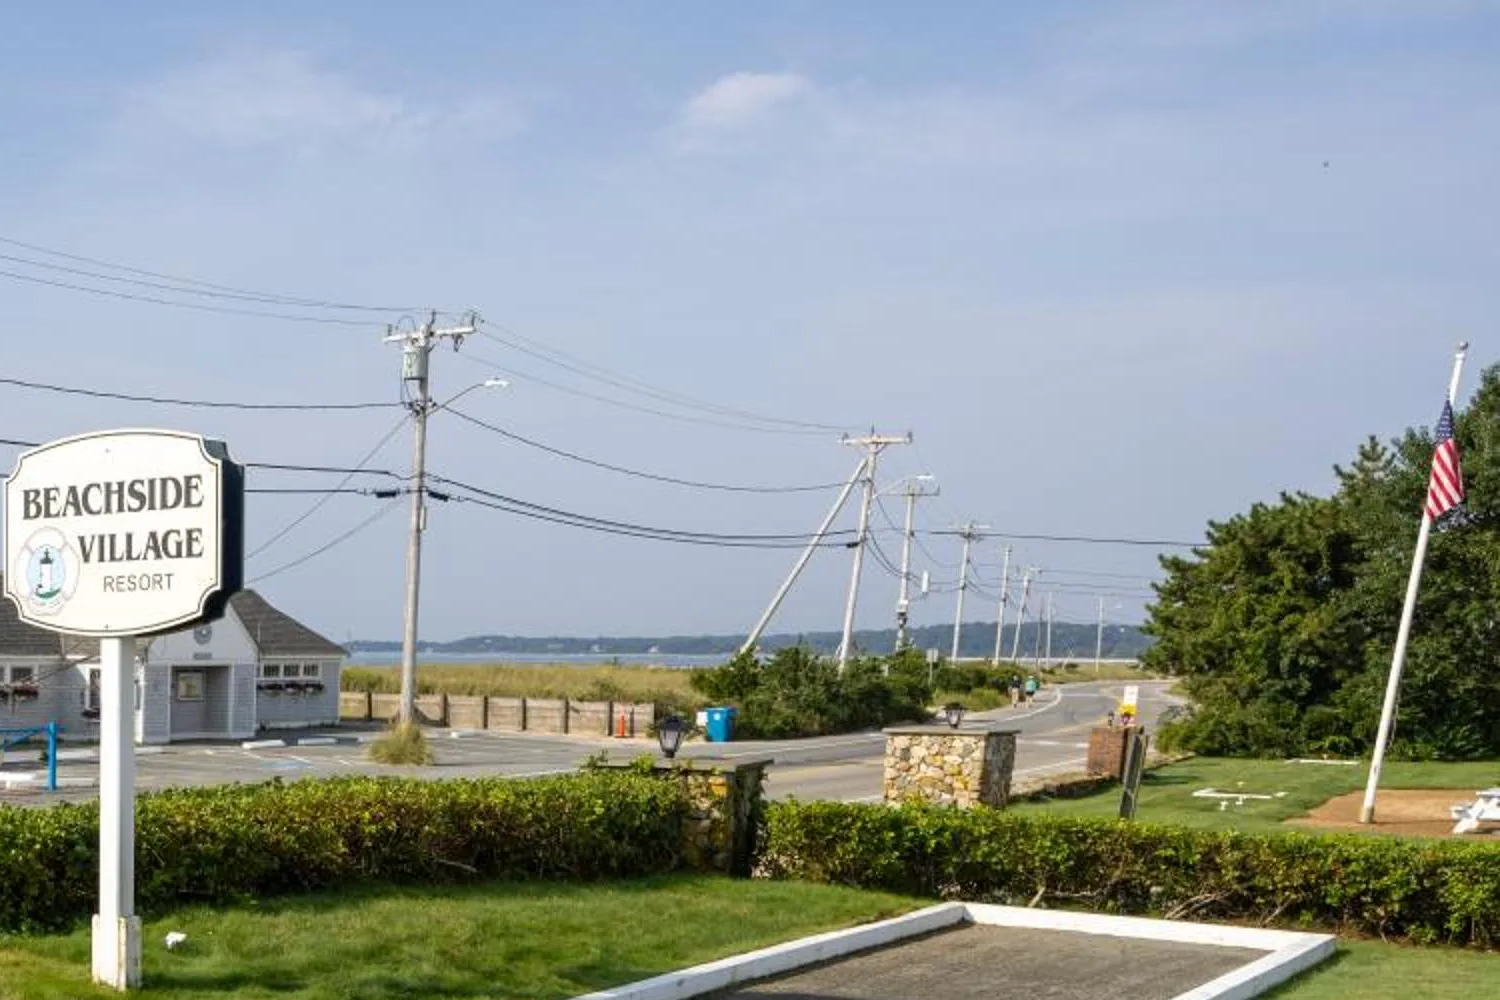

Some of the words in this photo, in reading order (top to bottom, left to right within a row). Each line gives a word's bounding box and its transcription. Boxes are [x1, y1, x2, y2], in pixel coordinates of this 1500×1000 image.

[23, 474, 204, 520] BEACHSIDE
[78, 528, 204, 563] VILLAGE
[103, 573, 174, 592] RESORT
